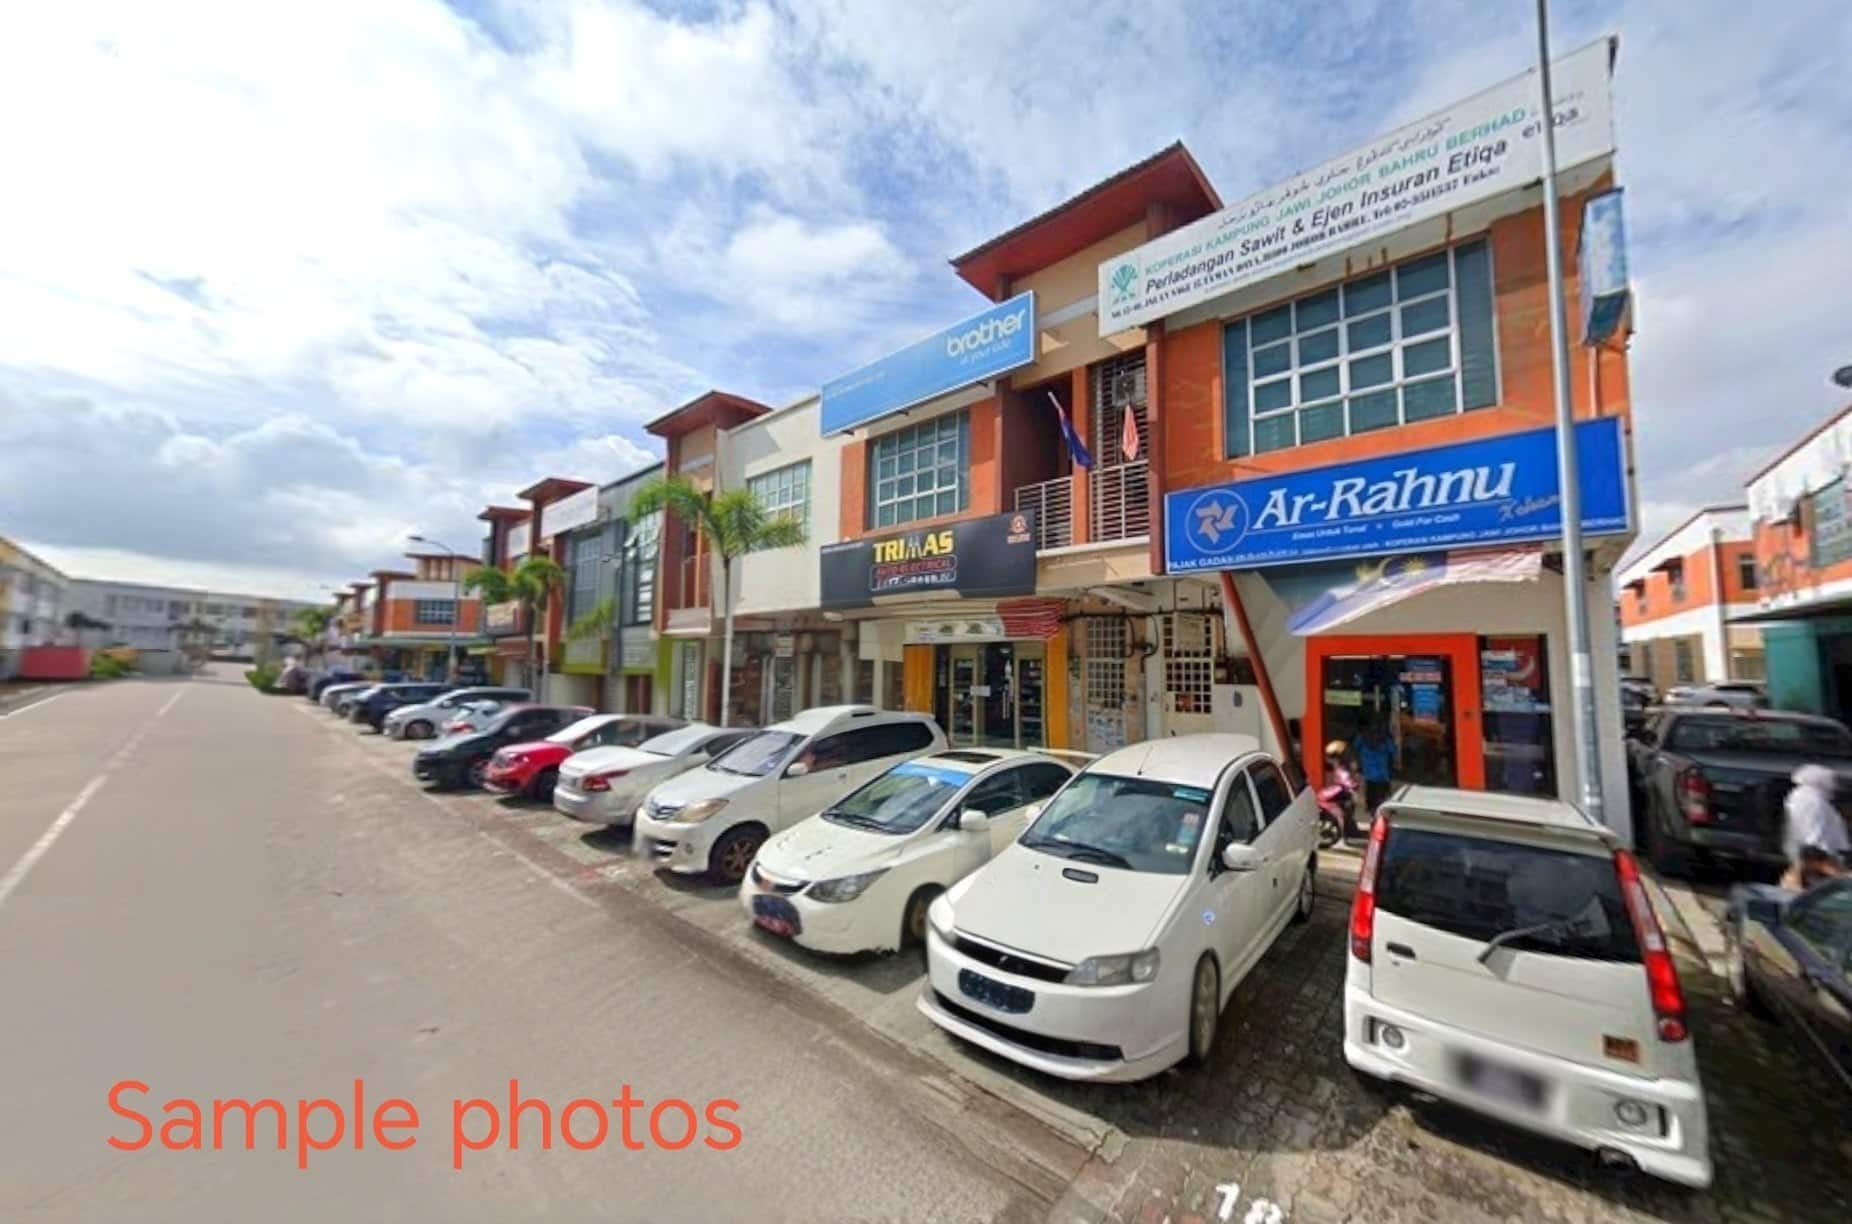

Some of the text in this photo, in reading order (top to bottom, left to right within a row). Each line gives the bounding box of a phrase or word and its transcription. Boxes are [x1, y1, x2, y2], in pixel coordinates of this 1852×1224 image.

[1146, 249, 1234, 294] Perladangan
[1240, 226, 1287, 256] Sawit
[1292, 218, 1304, 235] &
[1311, 200, 1354, 228] Ejen
[1360, 166, 1440, 208] Insuran
[1448, 139, 1507, 174] Etiqa
[1206, 216, 1271, 249] KAMPUNG
[1276, 197, 1312, 221] JAWI
[1317, 173, 1371, 201] JOHOR
[1379, 144, 1439, 177] BAHRU
[1446, 108, 1525, 150] BERHAD
[947, 308, 1026, 357] brother
[1252, 461, 1516, 530] Ar-Rahnu
